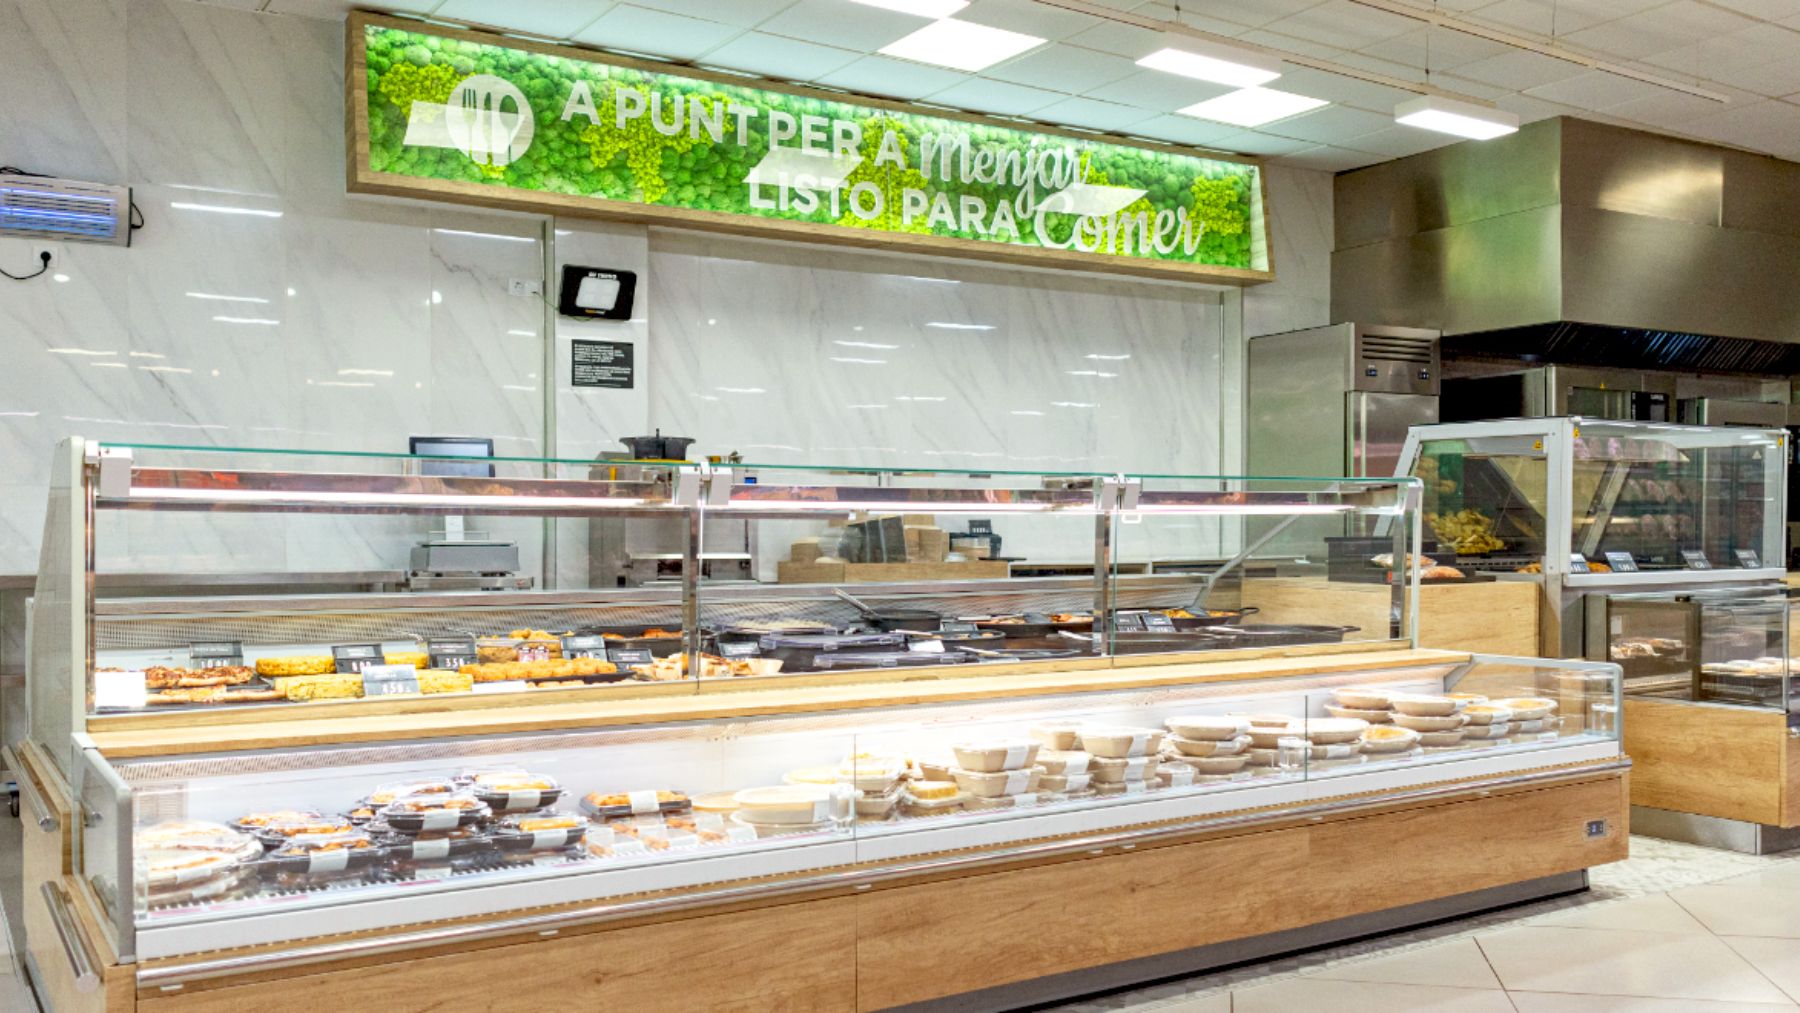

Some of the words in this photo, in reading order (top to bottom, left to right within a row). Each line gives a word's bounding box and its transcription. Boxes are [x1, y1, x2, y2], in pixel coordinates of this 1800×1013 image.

[561, 80, 601, 126] A
[616, 87, 758, 147] PUNT
[769, 110, 864, 162] PER
[874, 130, 907, 170] A
[920, 132, 1091, 219] Menjar
[749, 167, 885, 220] LISTO
[903, 188, 1020, 237] PARA
[1034, 192, 1205, 256] Comer
